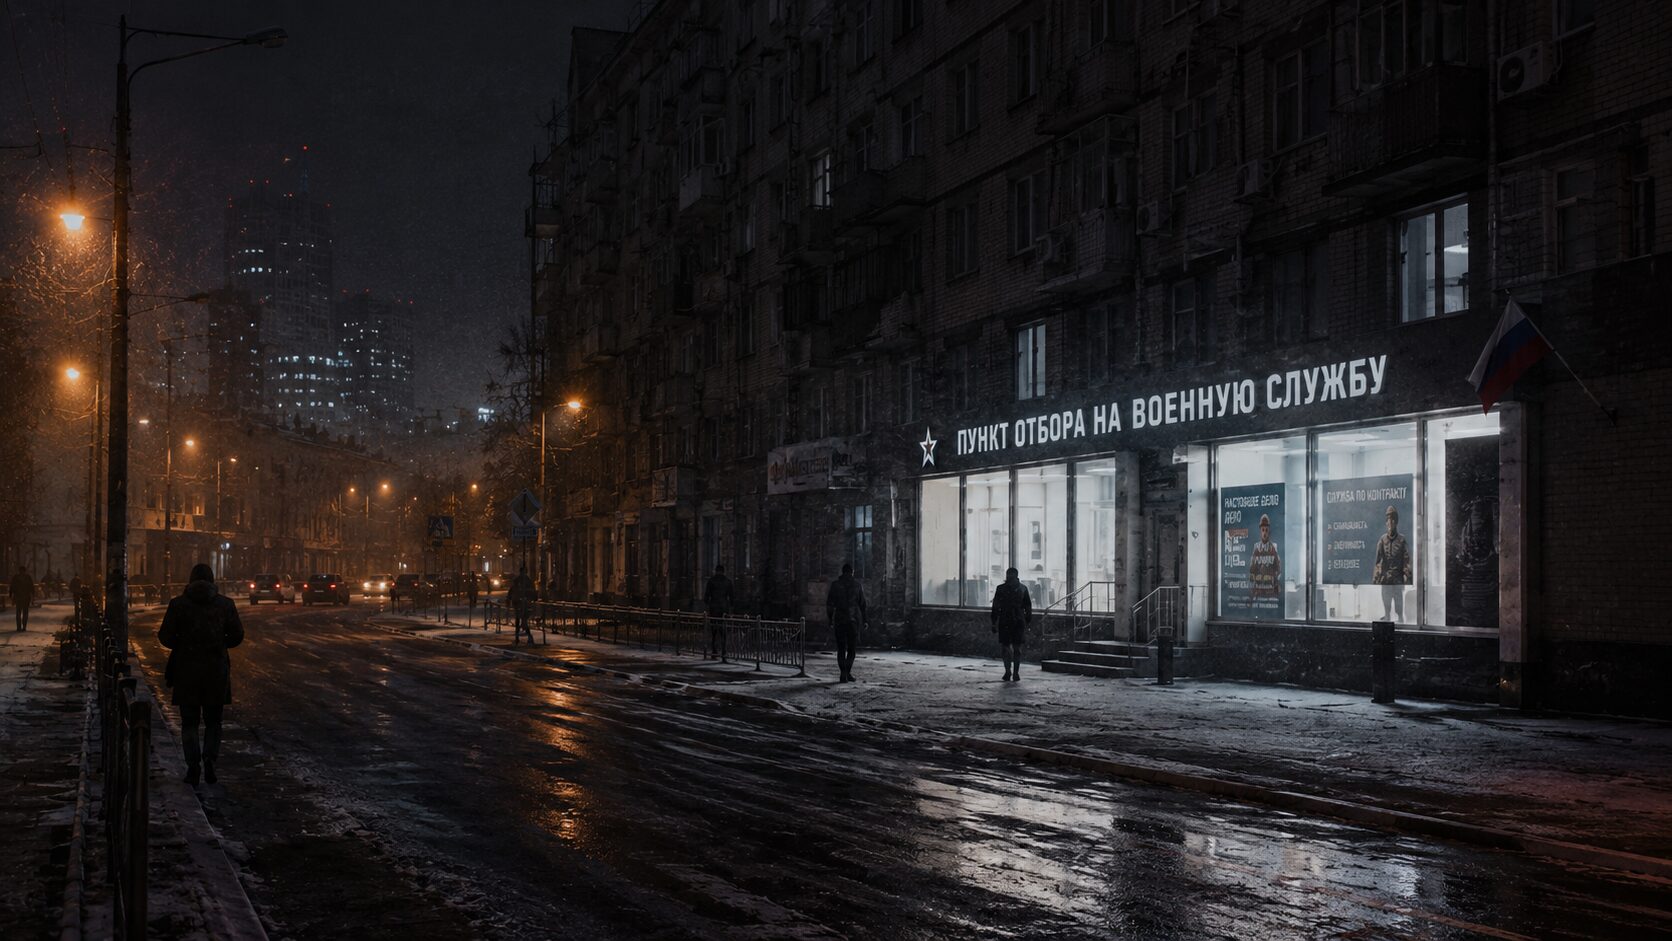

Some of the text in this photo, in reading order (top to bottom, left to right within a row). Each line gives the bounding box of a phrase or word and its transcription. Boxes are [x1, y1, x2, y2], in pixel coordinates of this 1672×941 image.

[957, 354, 1388, 455] ПУНКТ ОТБОРА НА ВОЕННУЮ СЛУЖБУ
